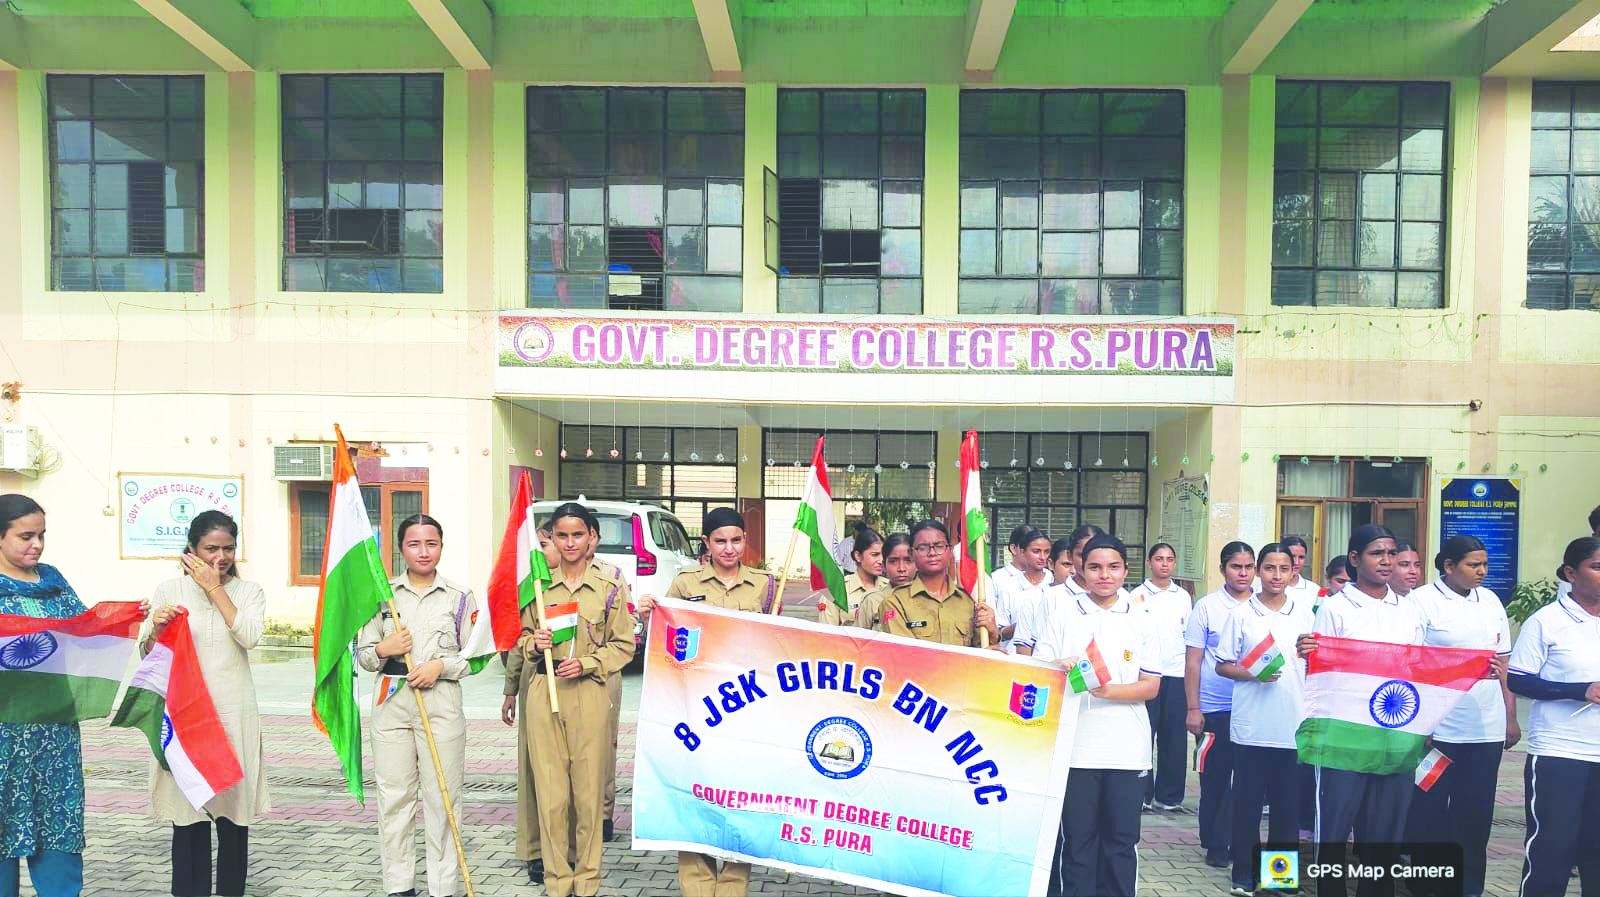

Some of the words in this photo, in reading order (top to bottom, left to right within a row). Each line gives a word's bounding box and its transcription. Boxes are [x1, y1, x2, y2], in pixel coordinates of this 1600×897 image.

[572, 323, 682, 364] GOVT.
[695, 326, 838, 366] DEGREE
[851, 328, 1016, 368] COLLEGE
[139, 485, 169, 505] DEGREE
[673, 722, 701, 752] 8
[702, 669, 768, 728] J&K
[776, 660, 883, 700] GIRLS
[892, 682, 949, 734] BN
[944, 730, 1008, 806] NCC
[692, 783, 818, 818] GOVERNMENT
[823, 801, 891, 830] DEGREE
[896, 816, 974, 849] COLLEGE
[780, 823, 816, 845] R.S.
[823, 828, 874, 854] PURA
